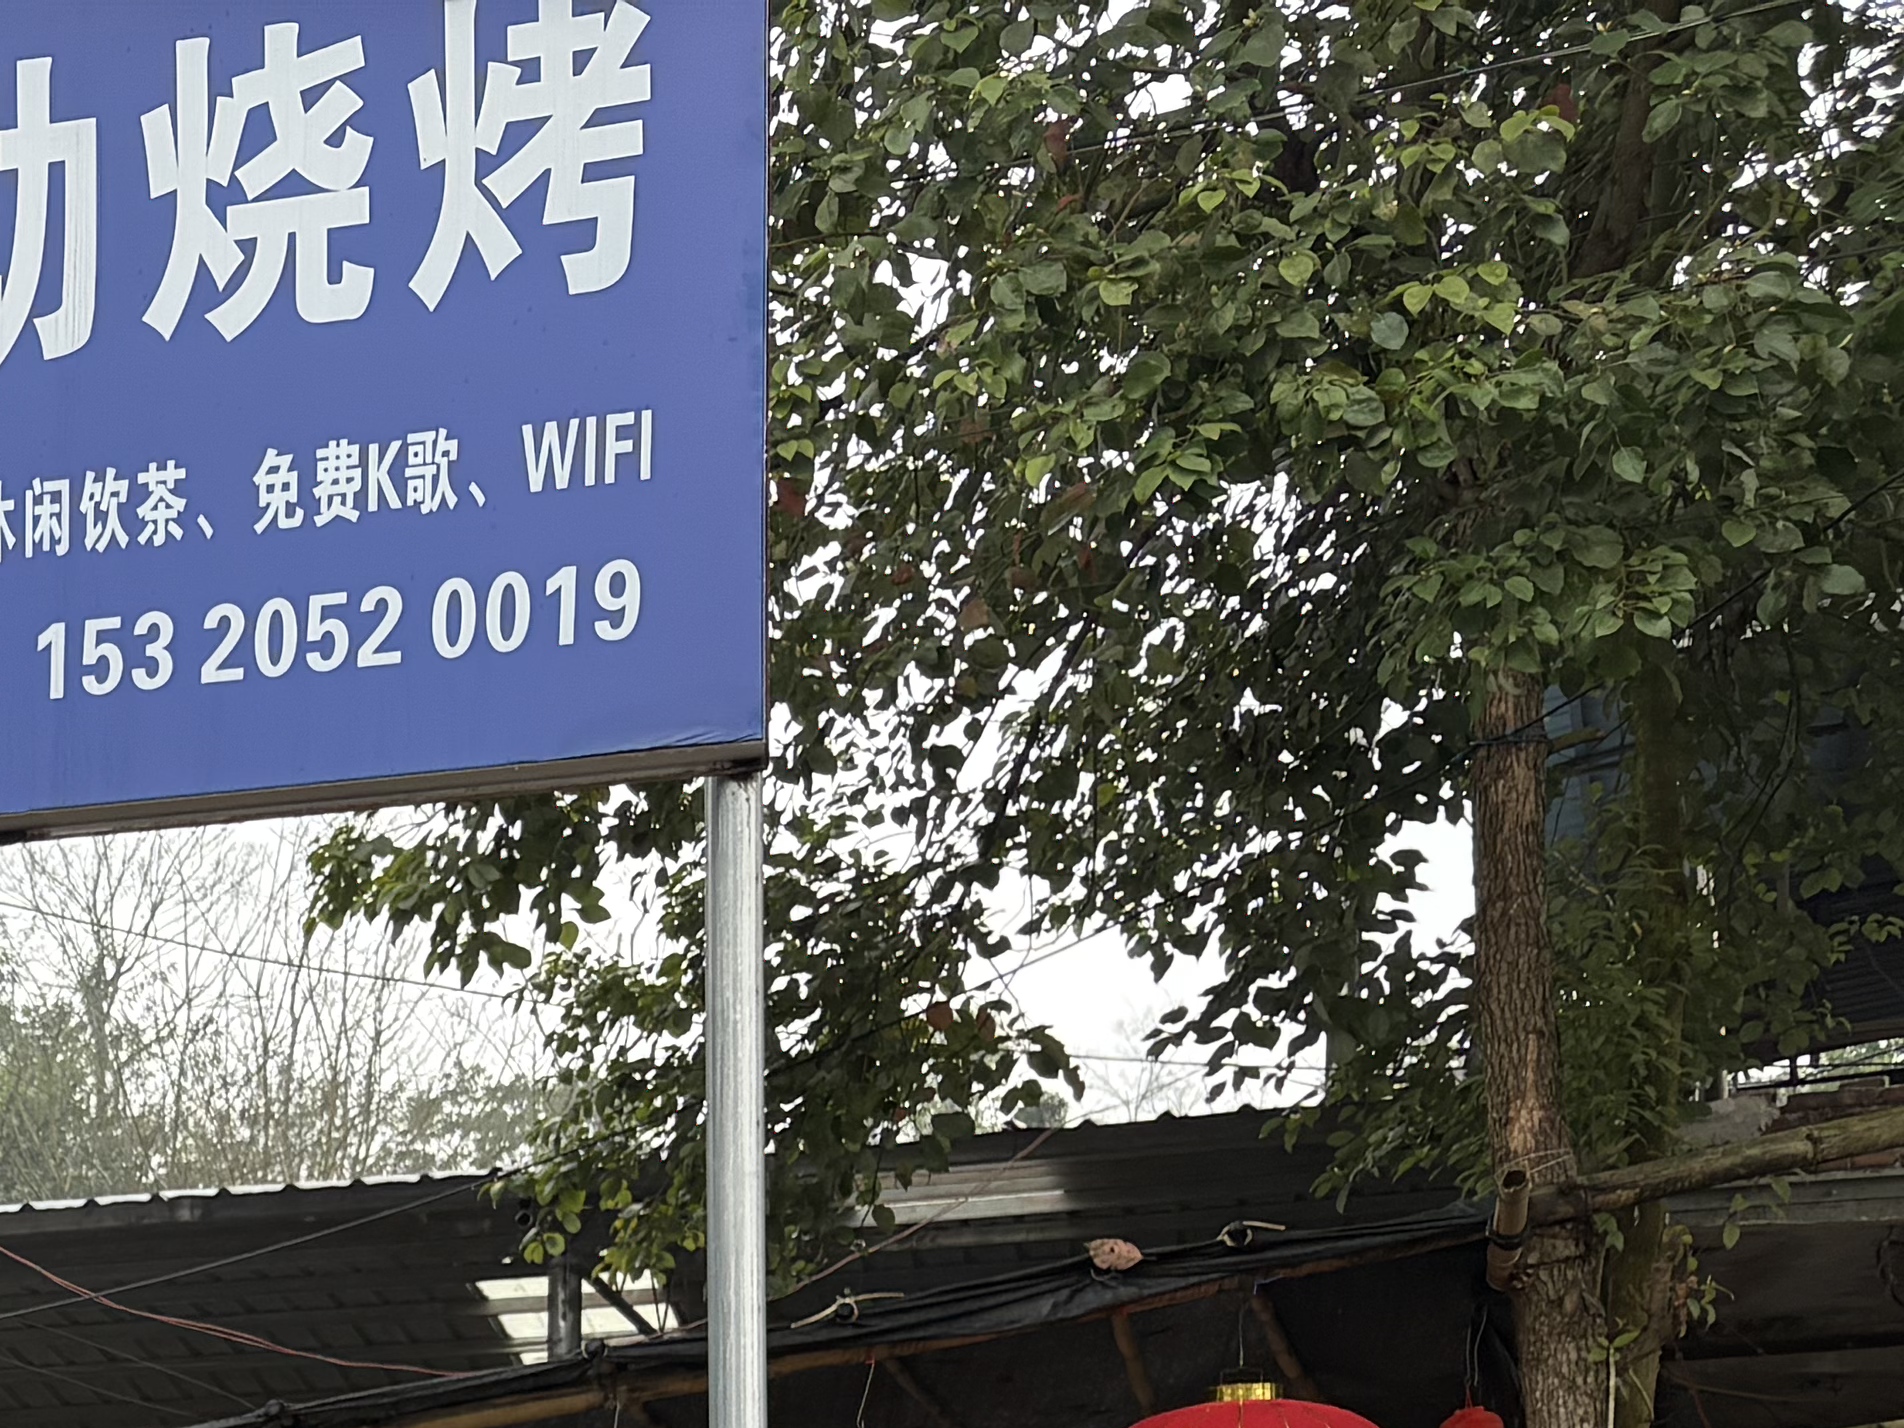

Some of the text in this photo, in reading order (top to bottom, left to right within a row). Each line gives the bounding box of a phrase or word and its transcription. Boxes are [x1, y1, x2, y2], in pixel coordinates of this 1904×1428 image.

[35, 610, 175, 700] 153
[200, 585, 403, 686] 2052
[431, 558, 642, 661] 0019
